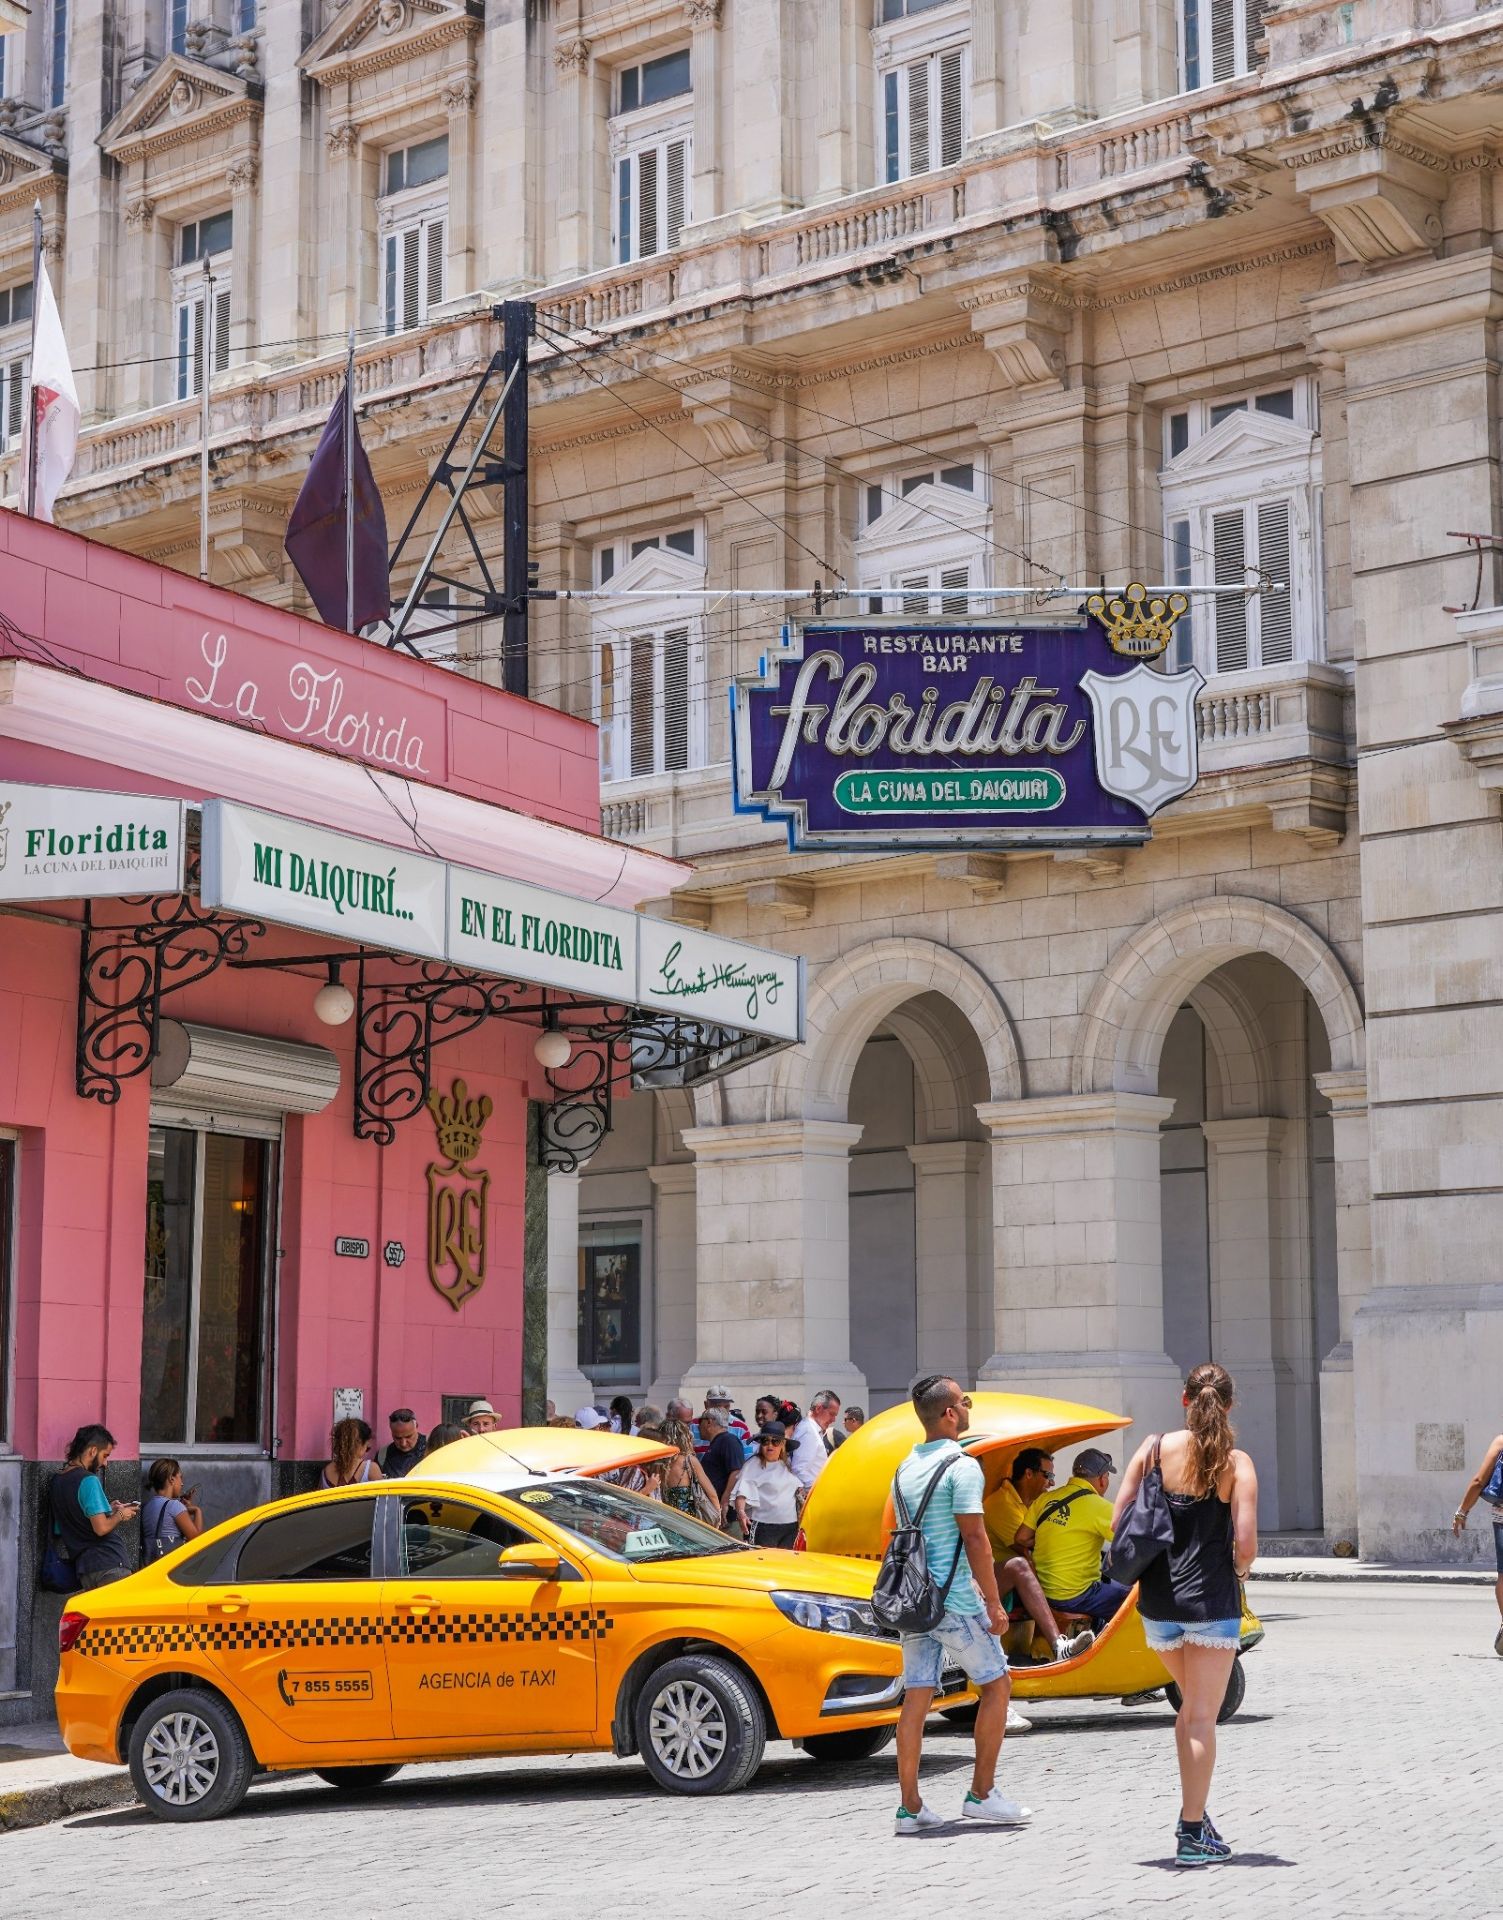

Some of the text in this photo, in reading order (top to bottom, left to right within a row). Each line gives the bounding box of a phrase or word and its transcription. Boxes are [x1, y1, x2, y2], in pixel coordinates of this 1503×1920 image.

[864, 633, 1024, 653] RESTAURANTE
[923, 655, 968, 673] BAR
[186, 631, 430, 774] La Florida
[850, 778, 1049, 802] LA CUNA DEL DAIQUIRI
[24, 822, 168, 858] Floridita
[24, 853, 168, 875] LA CUNA DEL DAIQUIRÍ
[253, 842, 414, 921] MI DAIQUIRÍ...
[461, 897, 623, 971] EN EL FLORIDITA
[708, 963, 784, 1020] Hemingway
[341, 1241, 365, 1255] OBISPO
[388, 1246, 401, 1262] 557
[636, 1533, 665, 1547] TAXI
[292, 1679, 369, 1693] 7 855 5555
[419, 1669, 556, 1689] AGENCIA de TAXI
